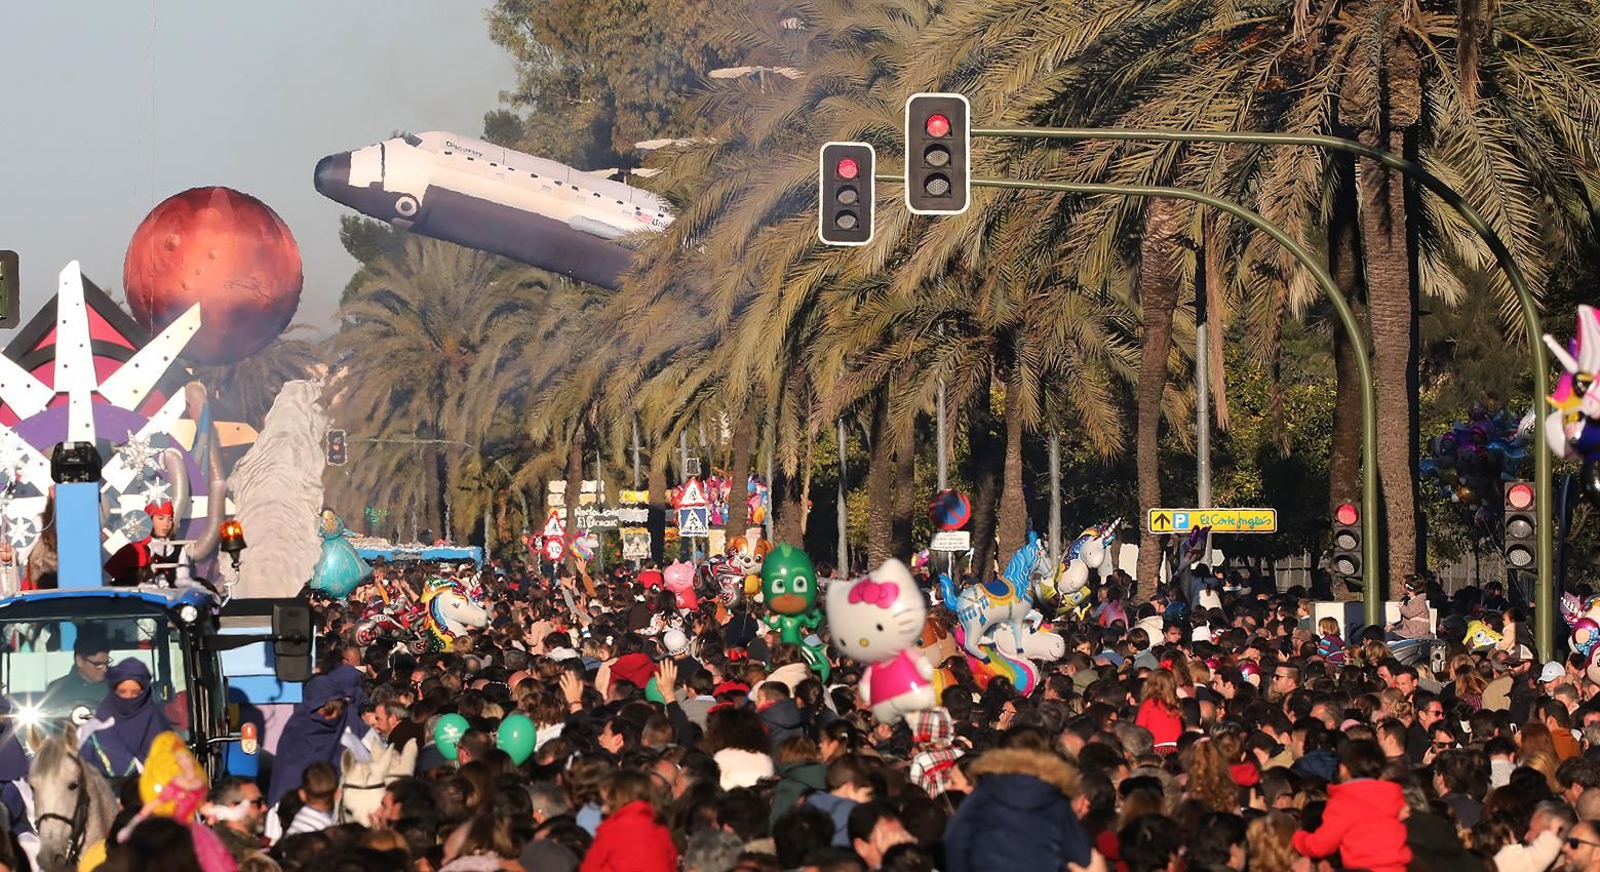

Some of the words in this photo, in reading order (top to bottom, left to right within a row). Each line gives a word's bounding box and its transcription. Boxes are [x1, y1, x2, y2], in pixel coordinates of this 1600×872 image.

[1175, 513, 1186, 528] P
[1200, 514, 1211, 525] El
[1211, 513, 1235, 526] Corte
[1237, 511, 1271, 529] Inglés
